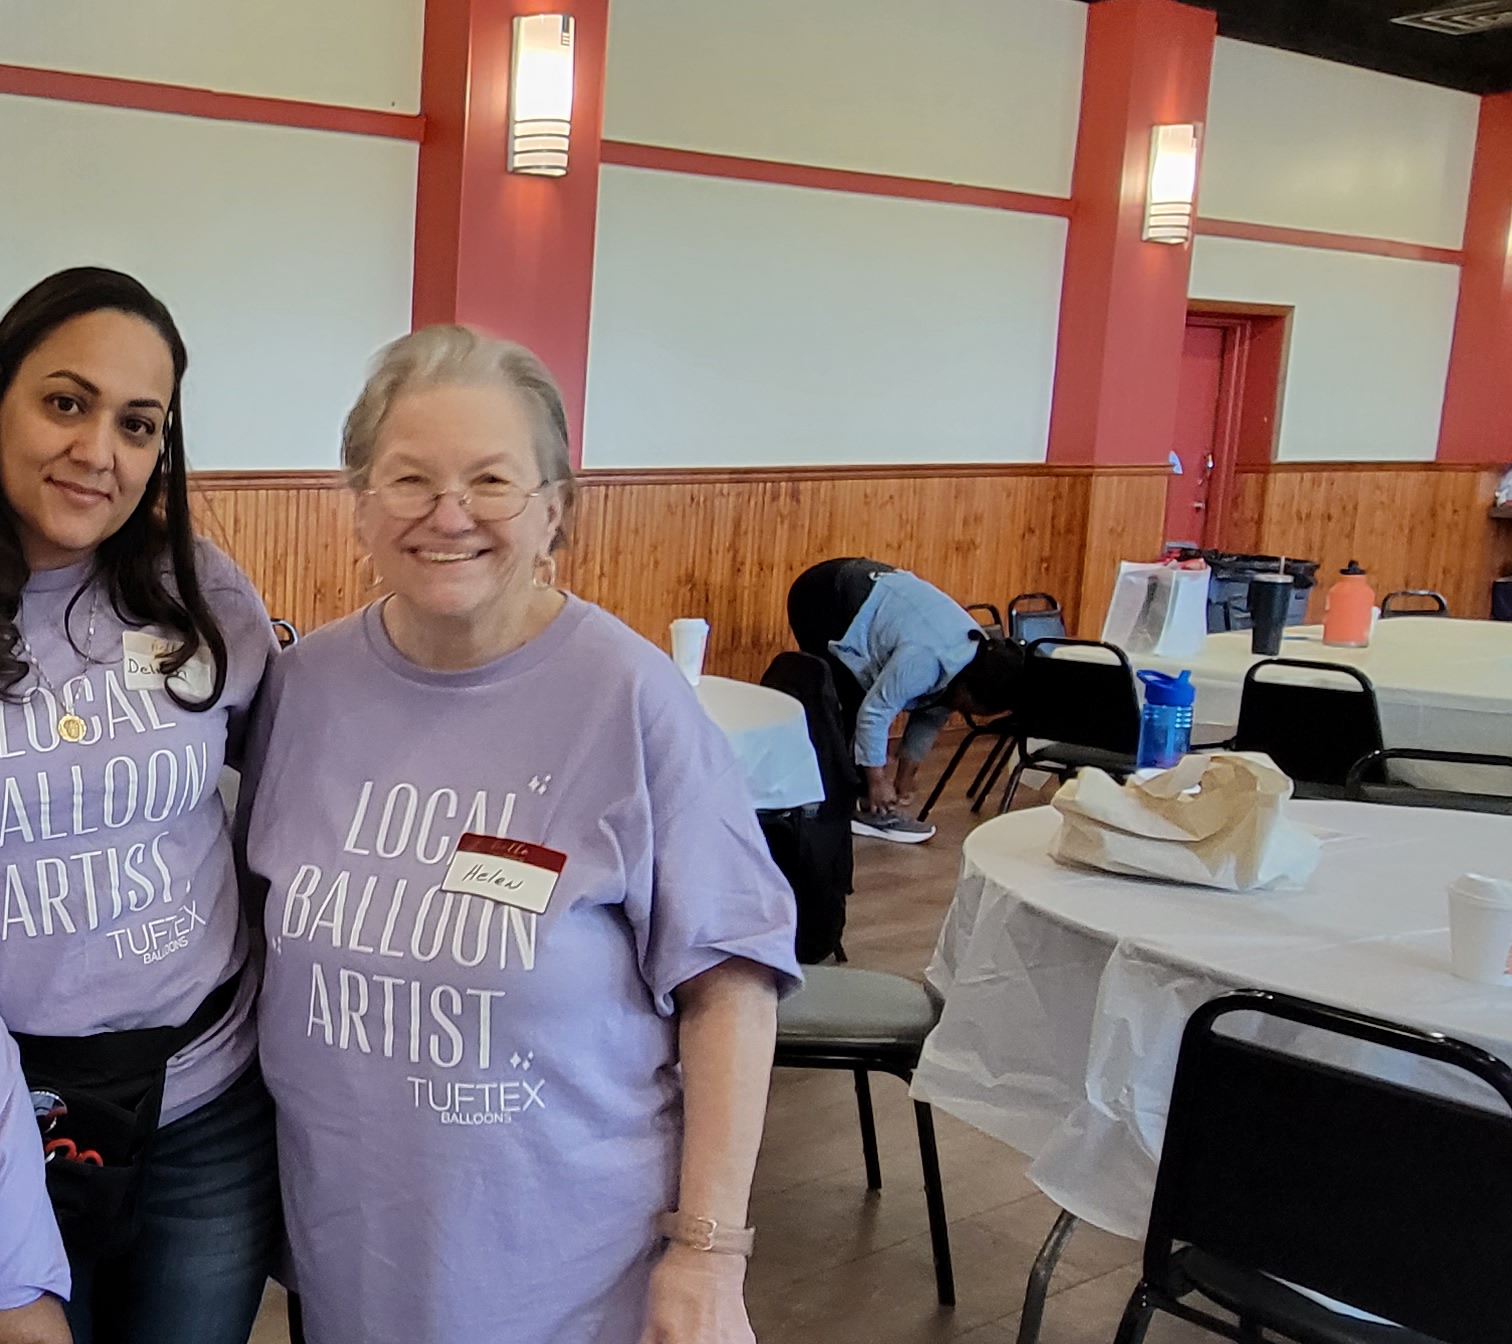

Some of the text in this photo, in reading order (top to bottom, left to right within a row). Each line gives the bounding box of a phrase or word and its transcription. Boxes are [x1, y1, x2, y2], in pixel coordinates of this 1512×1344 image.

[2, 831, 172, 941] ARTIST
[106, 900, 206, 960] TUFTEX
[282, 864, 537, 971] BALLOON
[143, 937, 188, 965] BALLOONS
[307, 963, 505, 1069] ARTIST
[407, 1076, 545, 1112] TUFTEX
[441, 1111, 511, 1125] BALLOONS
